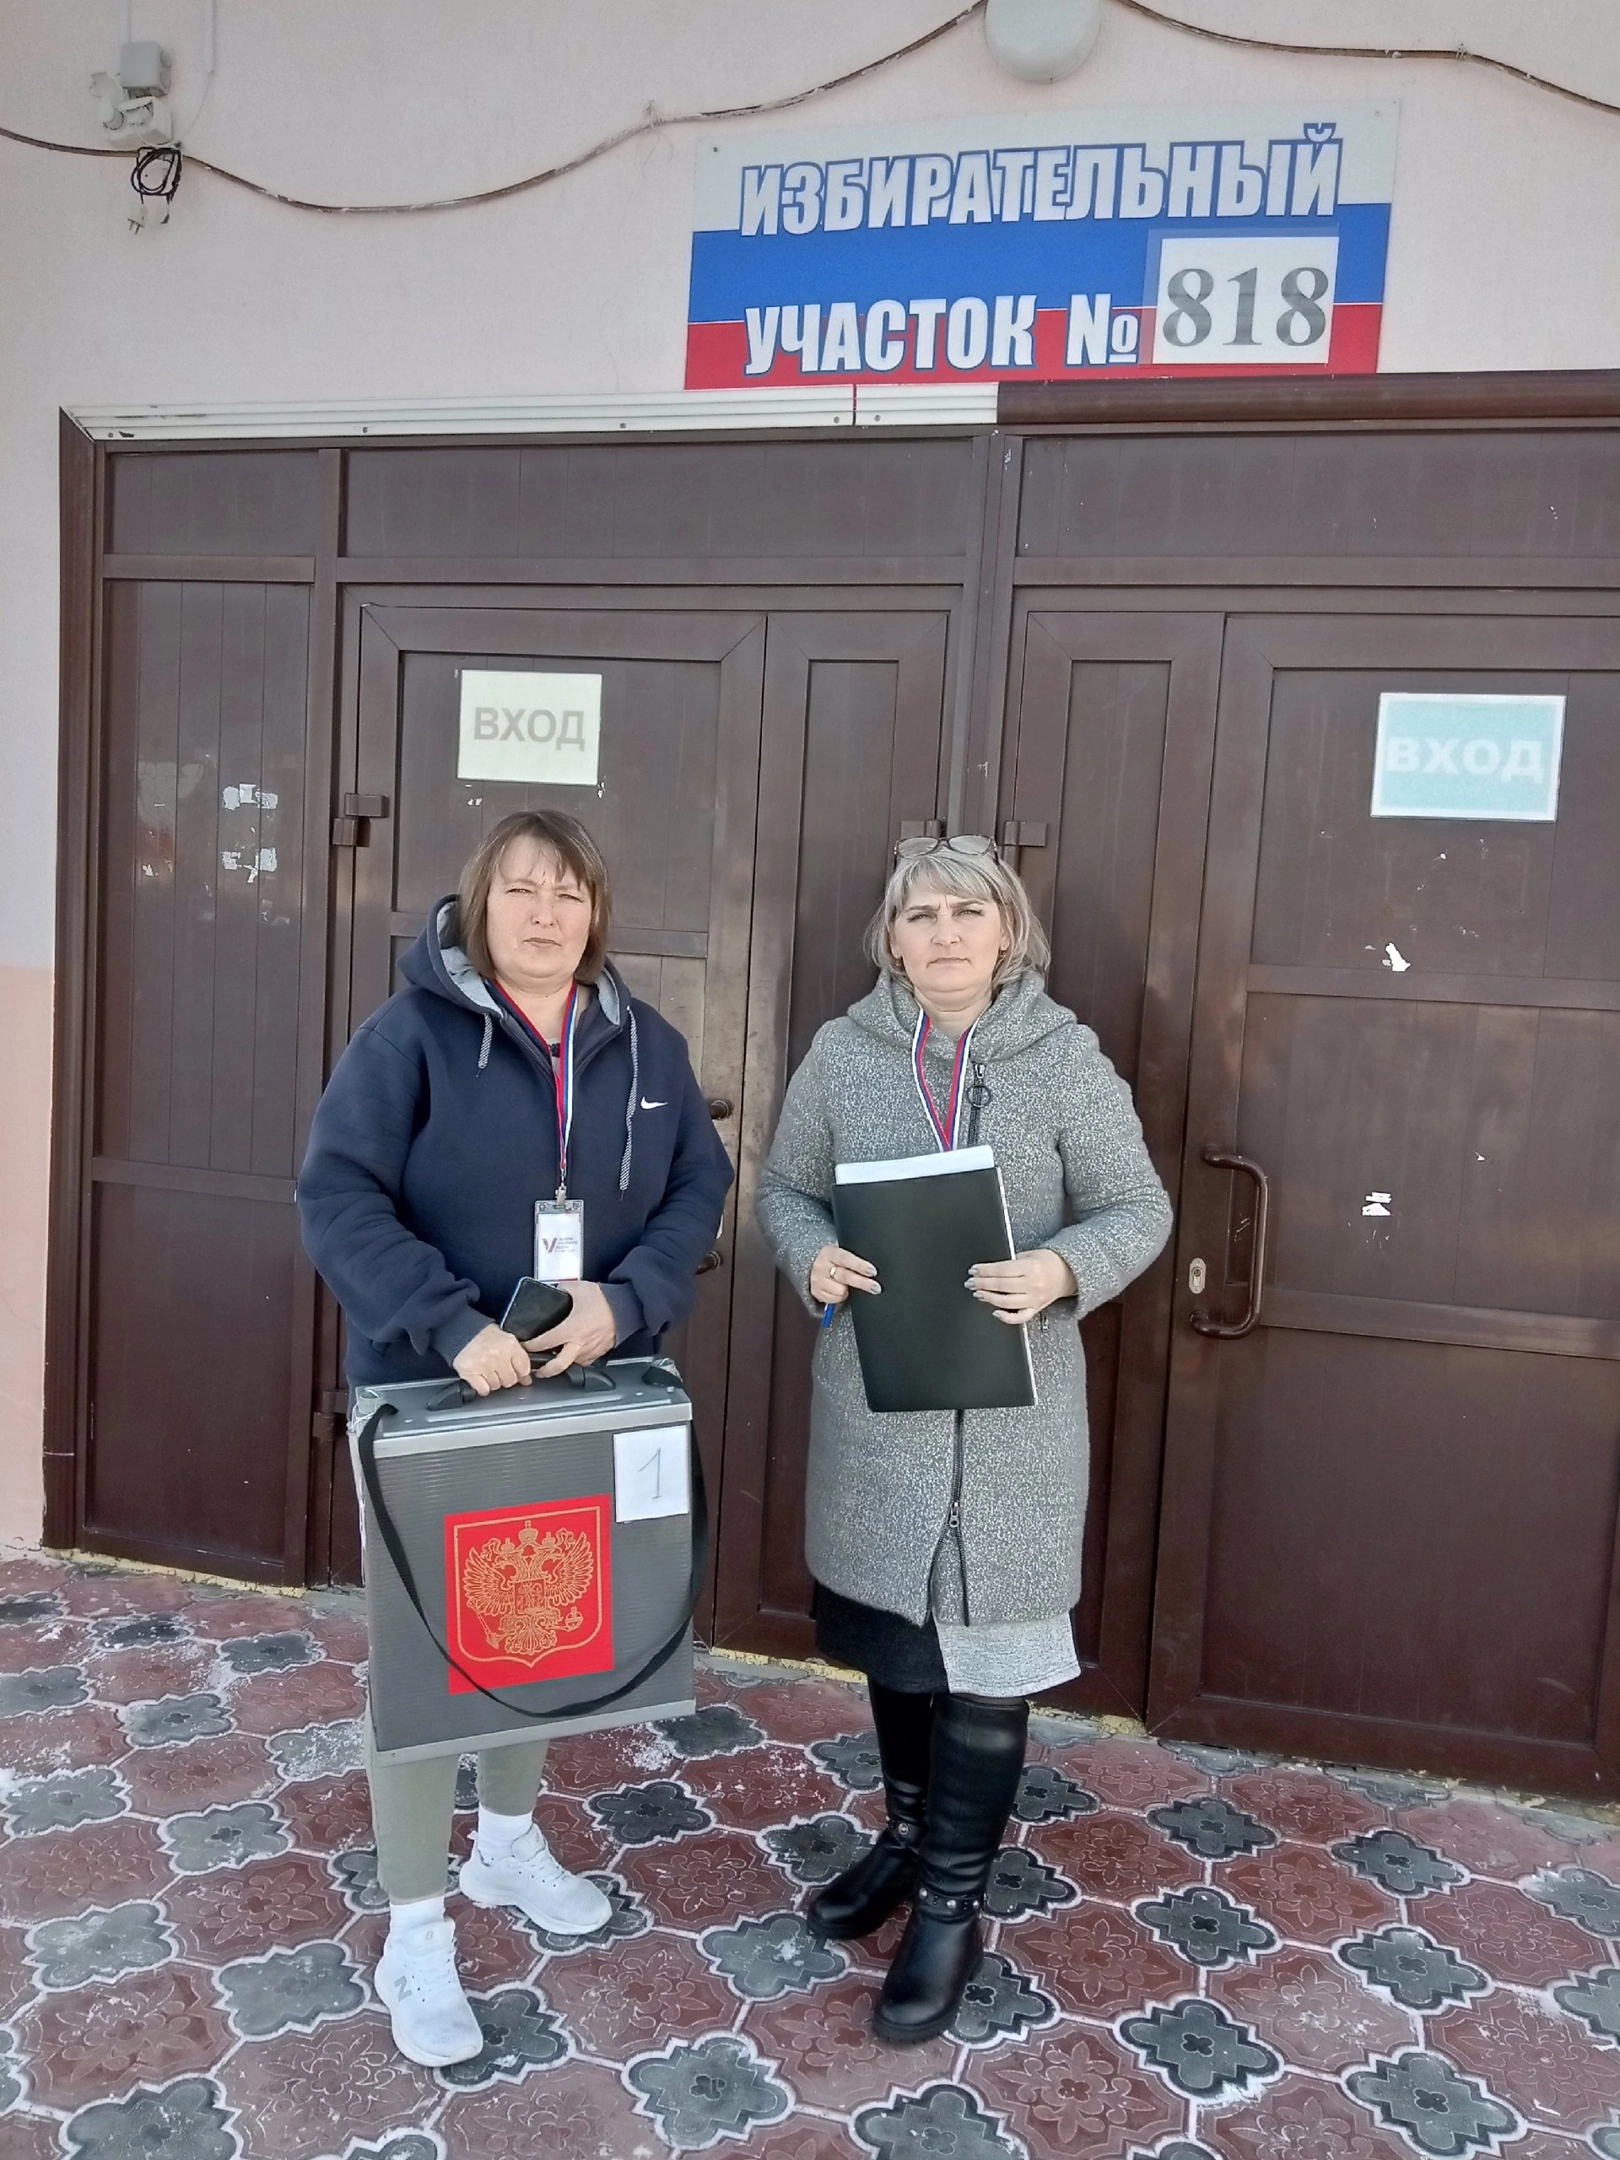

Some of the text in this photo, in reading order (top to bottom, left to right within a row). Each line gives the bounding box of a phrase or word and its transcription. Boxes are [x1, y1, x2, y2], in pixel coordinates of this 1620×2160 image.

[740, 123, 1343, 236] ИЗБИРАТЕЛЬНЫЙ
[744, 266, 1330, 376] УЧАСТОК № 818
[473, 706, 586, 752] ВХОД
[1386, 736, 1545, 785] ВХОД
[638, 1447, 662, 1500] 1
